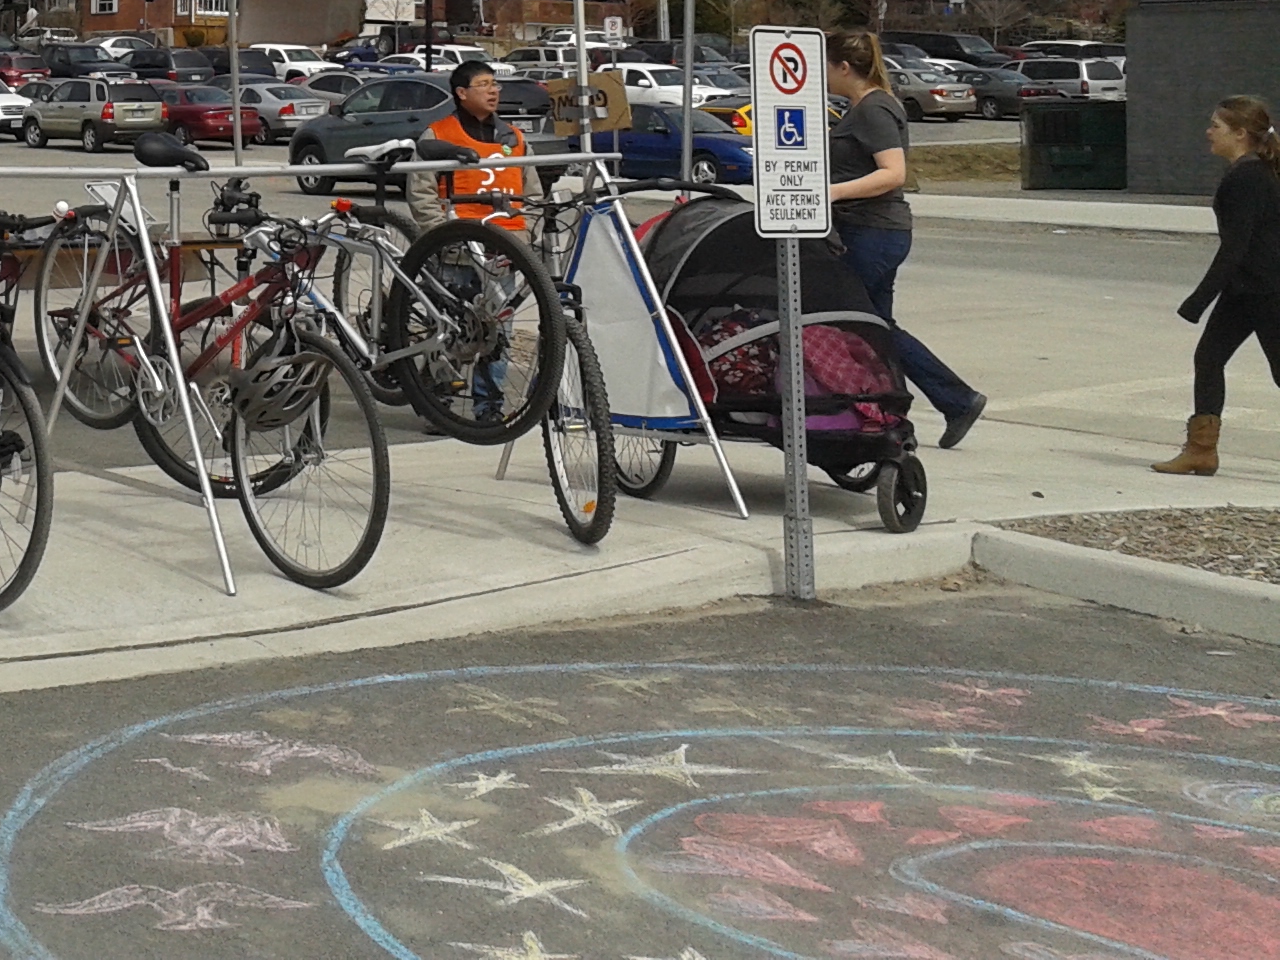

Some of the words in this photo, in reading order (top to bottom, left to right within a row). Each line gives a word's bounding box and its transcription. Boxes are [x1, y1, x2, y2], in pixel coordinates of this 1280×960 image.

[764, 160, 778, 173] BY
[784, 160, 818, 173] PERMIT
[779, 174, 804, 187] ONLY
[765, 194, 786, 206] AVEC
[790, 193, 821, 206] PERMIS
[769, 207, 817, 221] SEULEMENT
